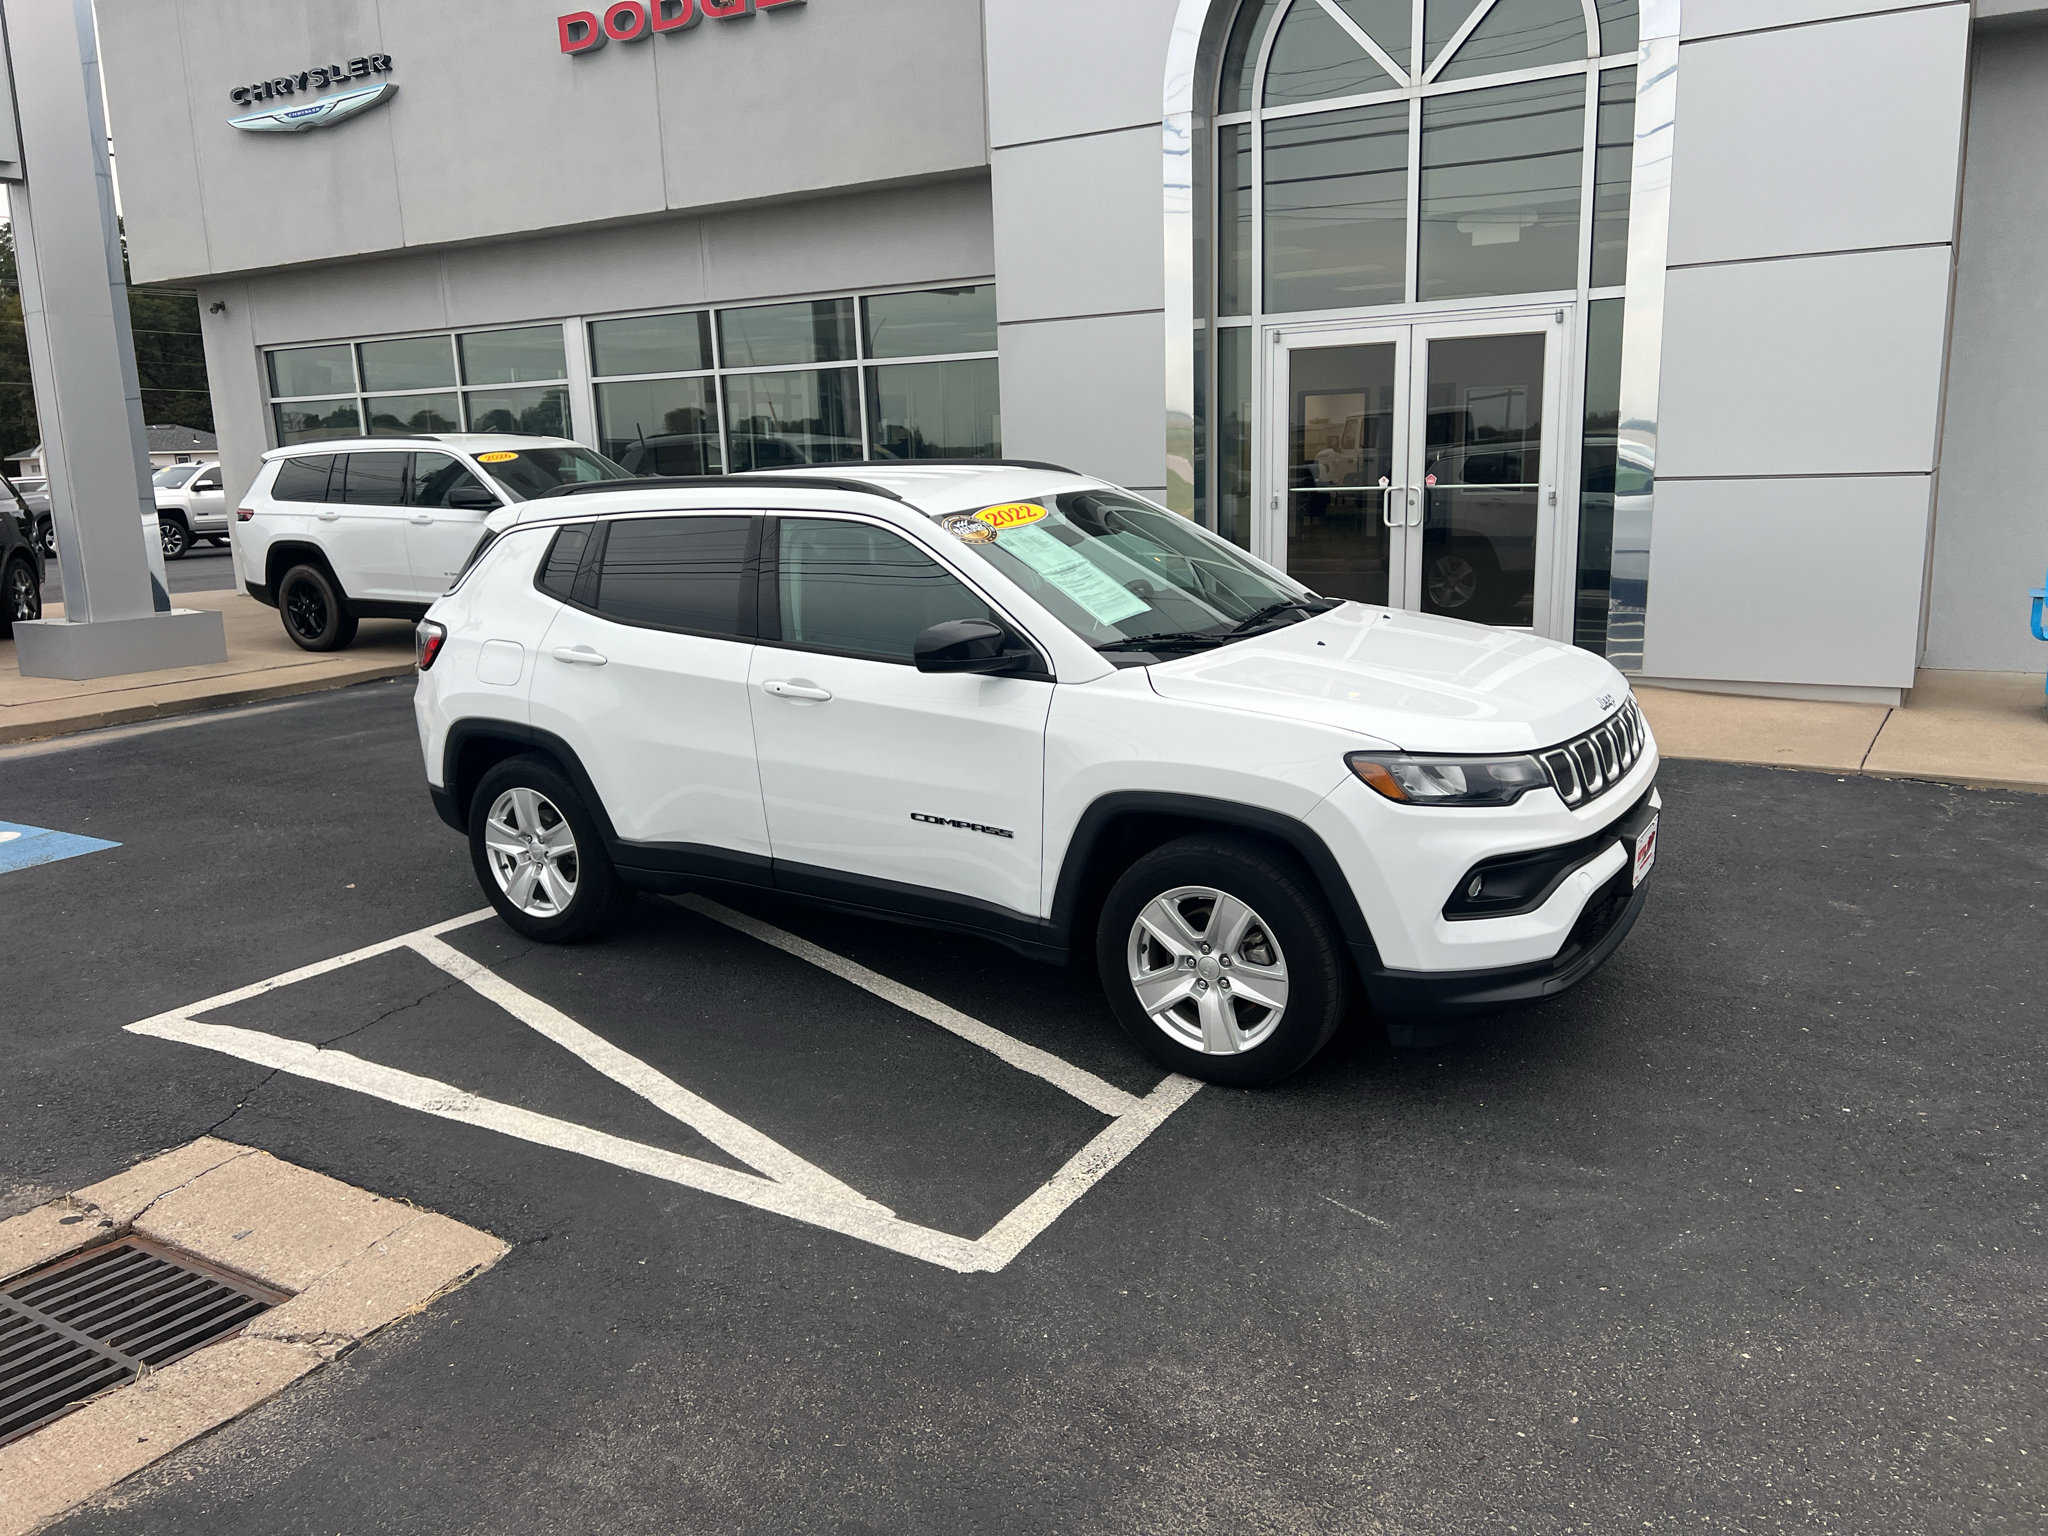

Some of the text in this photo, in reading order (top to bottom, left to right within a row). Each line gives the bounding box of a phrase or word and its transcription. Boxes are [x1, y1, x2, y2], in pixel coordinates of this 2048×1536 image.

[557, 0, 804, 54] DODG
[229, 53, 392, 105] CHRYSLER
[288, 107, 321, 117] CHRYSLER
[985, 505, 1037, 527] 2022
[910, 812, 1014, 839] COMPASS
